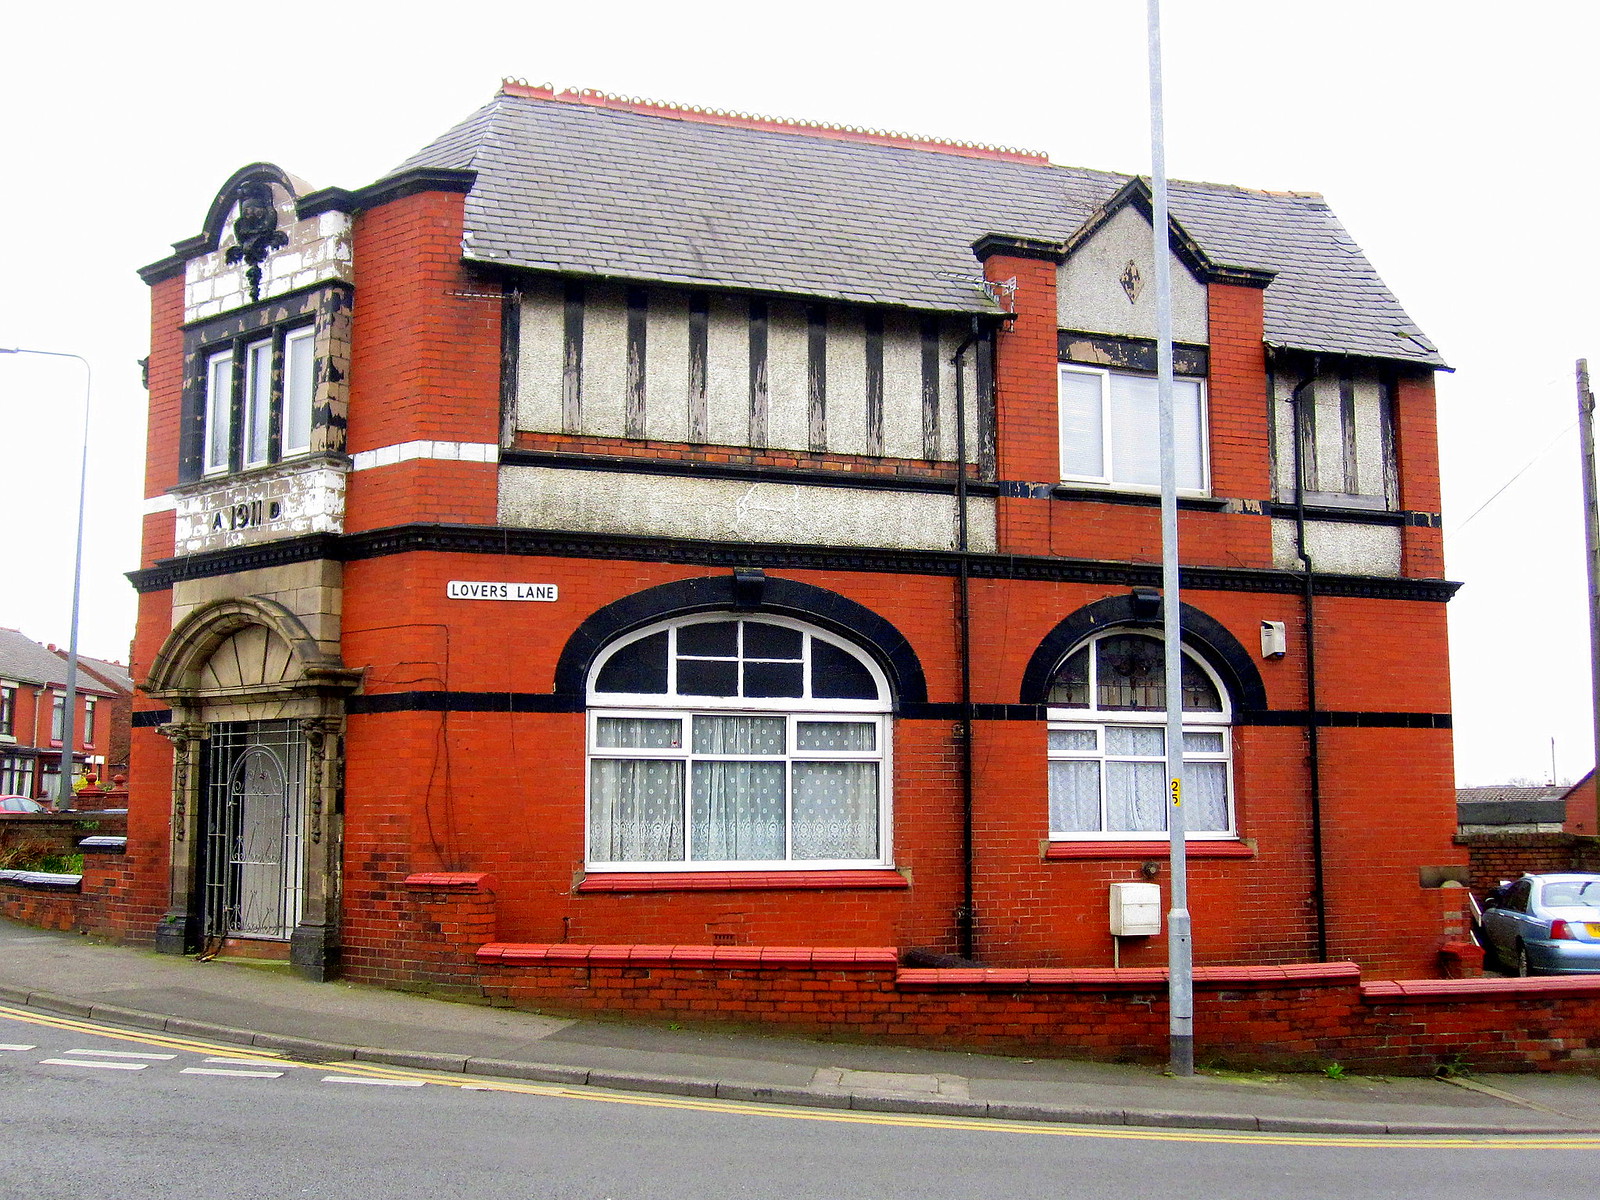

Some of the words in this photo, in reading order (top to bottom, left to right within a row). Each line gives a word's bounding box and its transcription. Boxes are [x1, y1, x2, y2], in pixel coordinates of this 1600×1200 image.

[212, 512, 222, 530] A
[229, 500, 262, 530] 1911
[269, 501, 280, 519] D
[452, 584, 508, 598] LOVERS
[517, 586, 554, 599] LANE
[1171, 781, 1179, 804] 25
